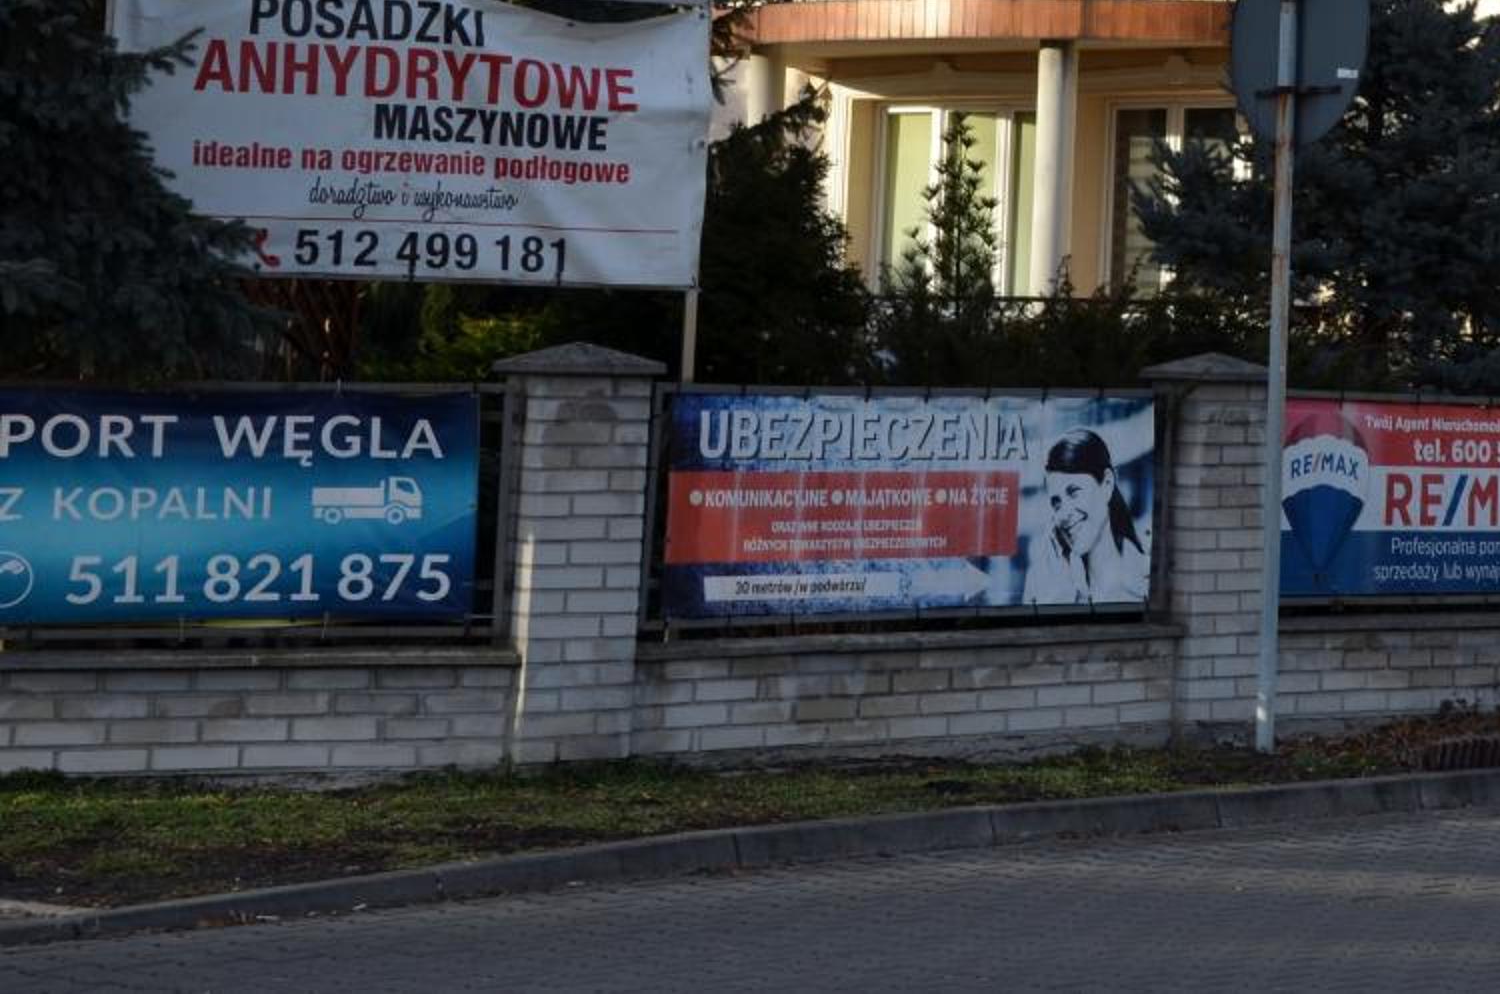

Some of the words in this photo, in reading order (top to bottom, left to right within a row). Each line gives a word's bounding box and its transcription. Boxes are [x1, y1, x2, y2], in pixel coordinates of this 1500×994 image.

[194, 39, 640, 113] ANHYDRYTOWE
[373, 103, 609, 152] MASZYNOWE
[192, 140, 292, 170] idealne
[301, 145, 333, 172] na
[341, 150, 486, 180] ogrzewanie
[493, 154, 630, 185] podłogowe
[294, 229, 379, 267] 512
[396, 232, 479, 272] 499
[495, 237, 567, 273] 181
[0, 414, 179, 458] PORT
[213, 415, 444, 467] WĘGLA
[700, 409, 1030, 461] UBEZPIECZENIA
[1413, 439, 1446, 463] tel.
[1451, 440, 1491, 463] 600
[1290, 452, 1360, 480] RE/MAX
[53, 487, 272, 520] KOPALNI
[705, 489, 828, 509] KOMUNIKACYJNE
[1391, 536, 1477, 558] Profesjonalna
[66, 555, 185, 605] 511
[202, 553, 319, 603] 821
[337, 553, 451, 602] 875
[1443, 560, 1463, 580] lub
